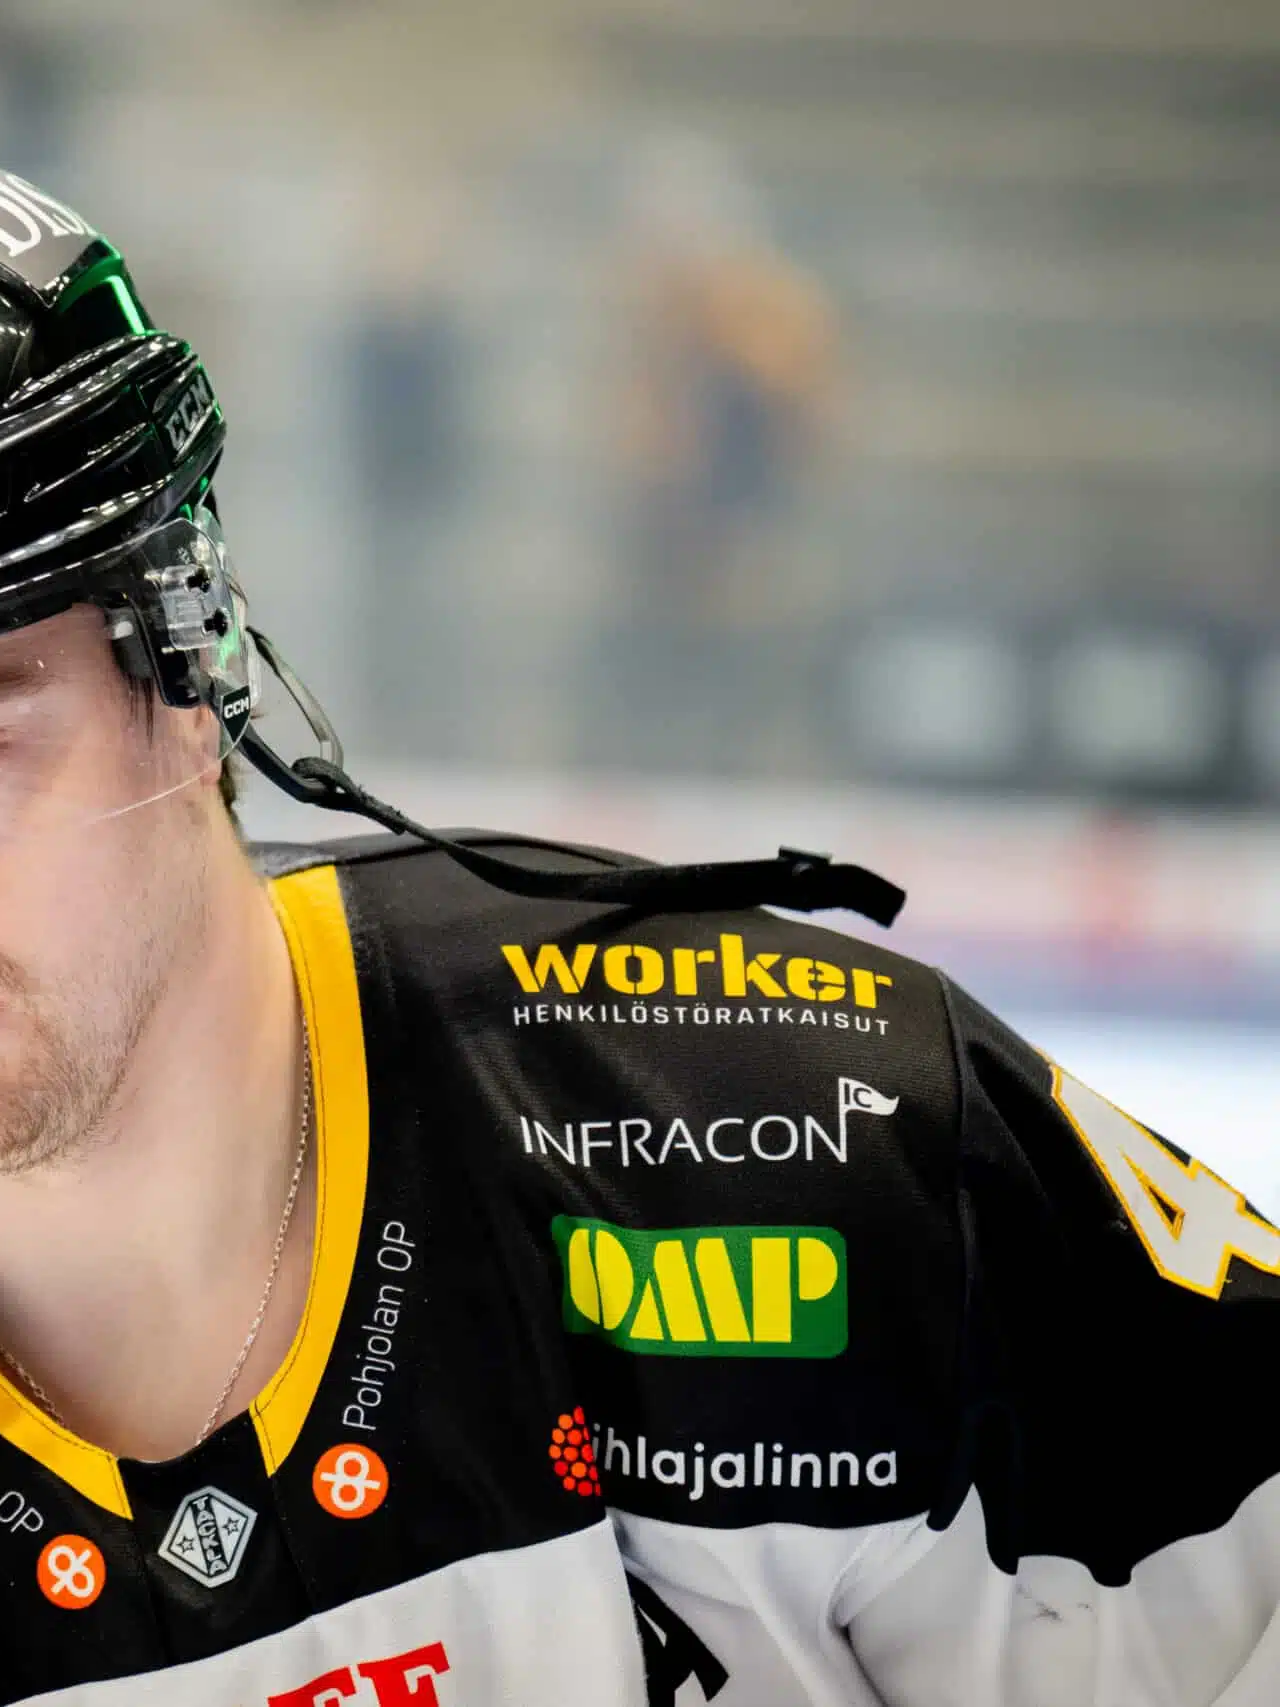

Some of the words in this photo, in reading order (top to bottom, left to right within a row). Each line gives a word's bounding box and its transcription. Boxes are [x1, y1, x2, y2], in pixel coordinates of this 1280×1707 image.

[223, 696, 250, 719] CCM
[501, 934, 893, 1009] worker
[513, 1001, 890, 1036] HENKILÖSTÖRATKAISUT
[520, 1077, 848, 1168] INFRACON
[569, 1229, 837, 1343] OMP
[342, 1284, 405, 1431] Pohjolan
[376, 1220, 416, 1273] OP
[593, 1423, 898, 1501] ihlajalinna
